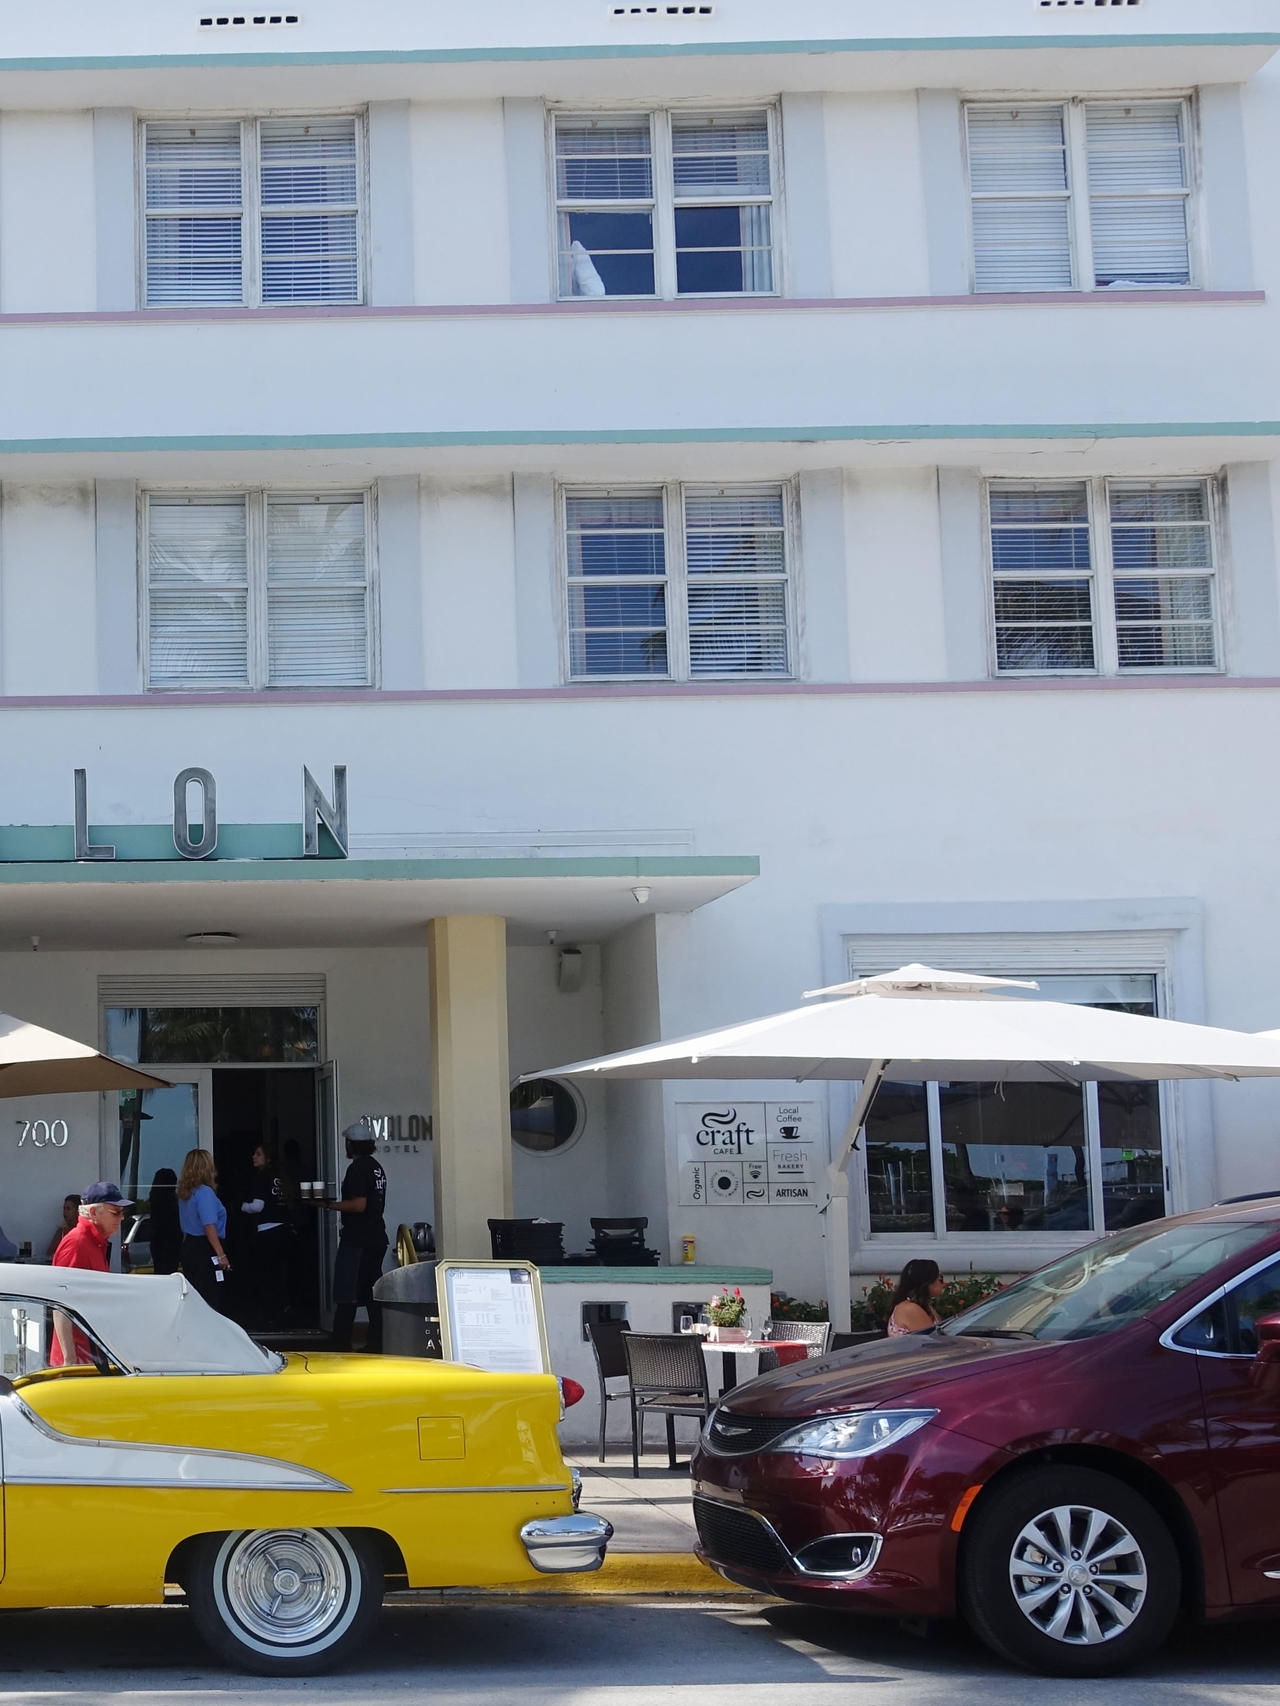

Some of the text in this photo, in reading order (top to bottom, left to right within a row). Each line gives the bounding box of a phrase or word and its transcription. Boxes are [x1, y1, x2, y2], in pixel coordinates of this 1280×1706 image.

[778, 1106, 799, 1114] Local
[776, 1115, 802, 1123] Coffee
[16, 1119, 68, 1147] 700
[696, 1122, 754, 1155] craft
[773, 1149, 808, 1162] Fresh
[693, 1167, 703, 1200] Organic
[775, 1188, 808, 1198] ARTISAN
